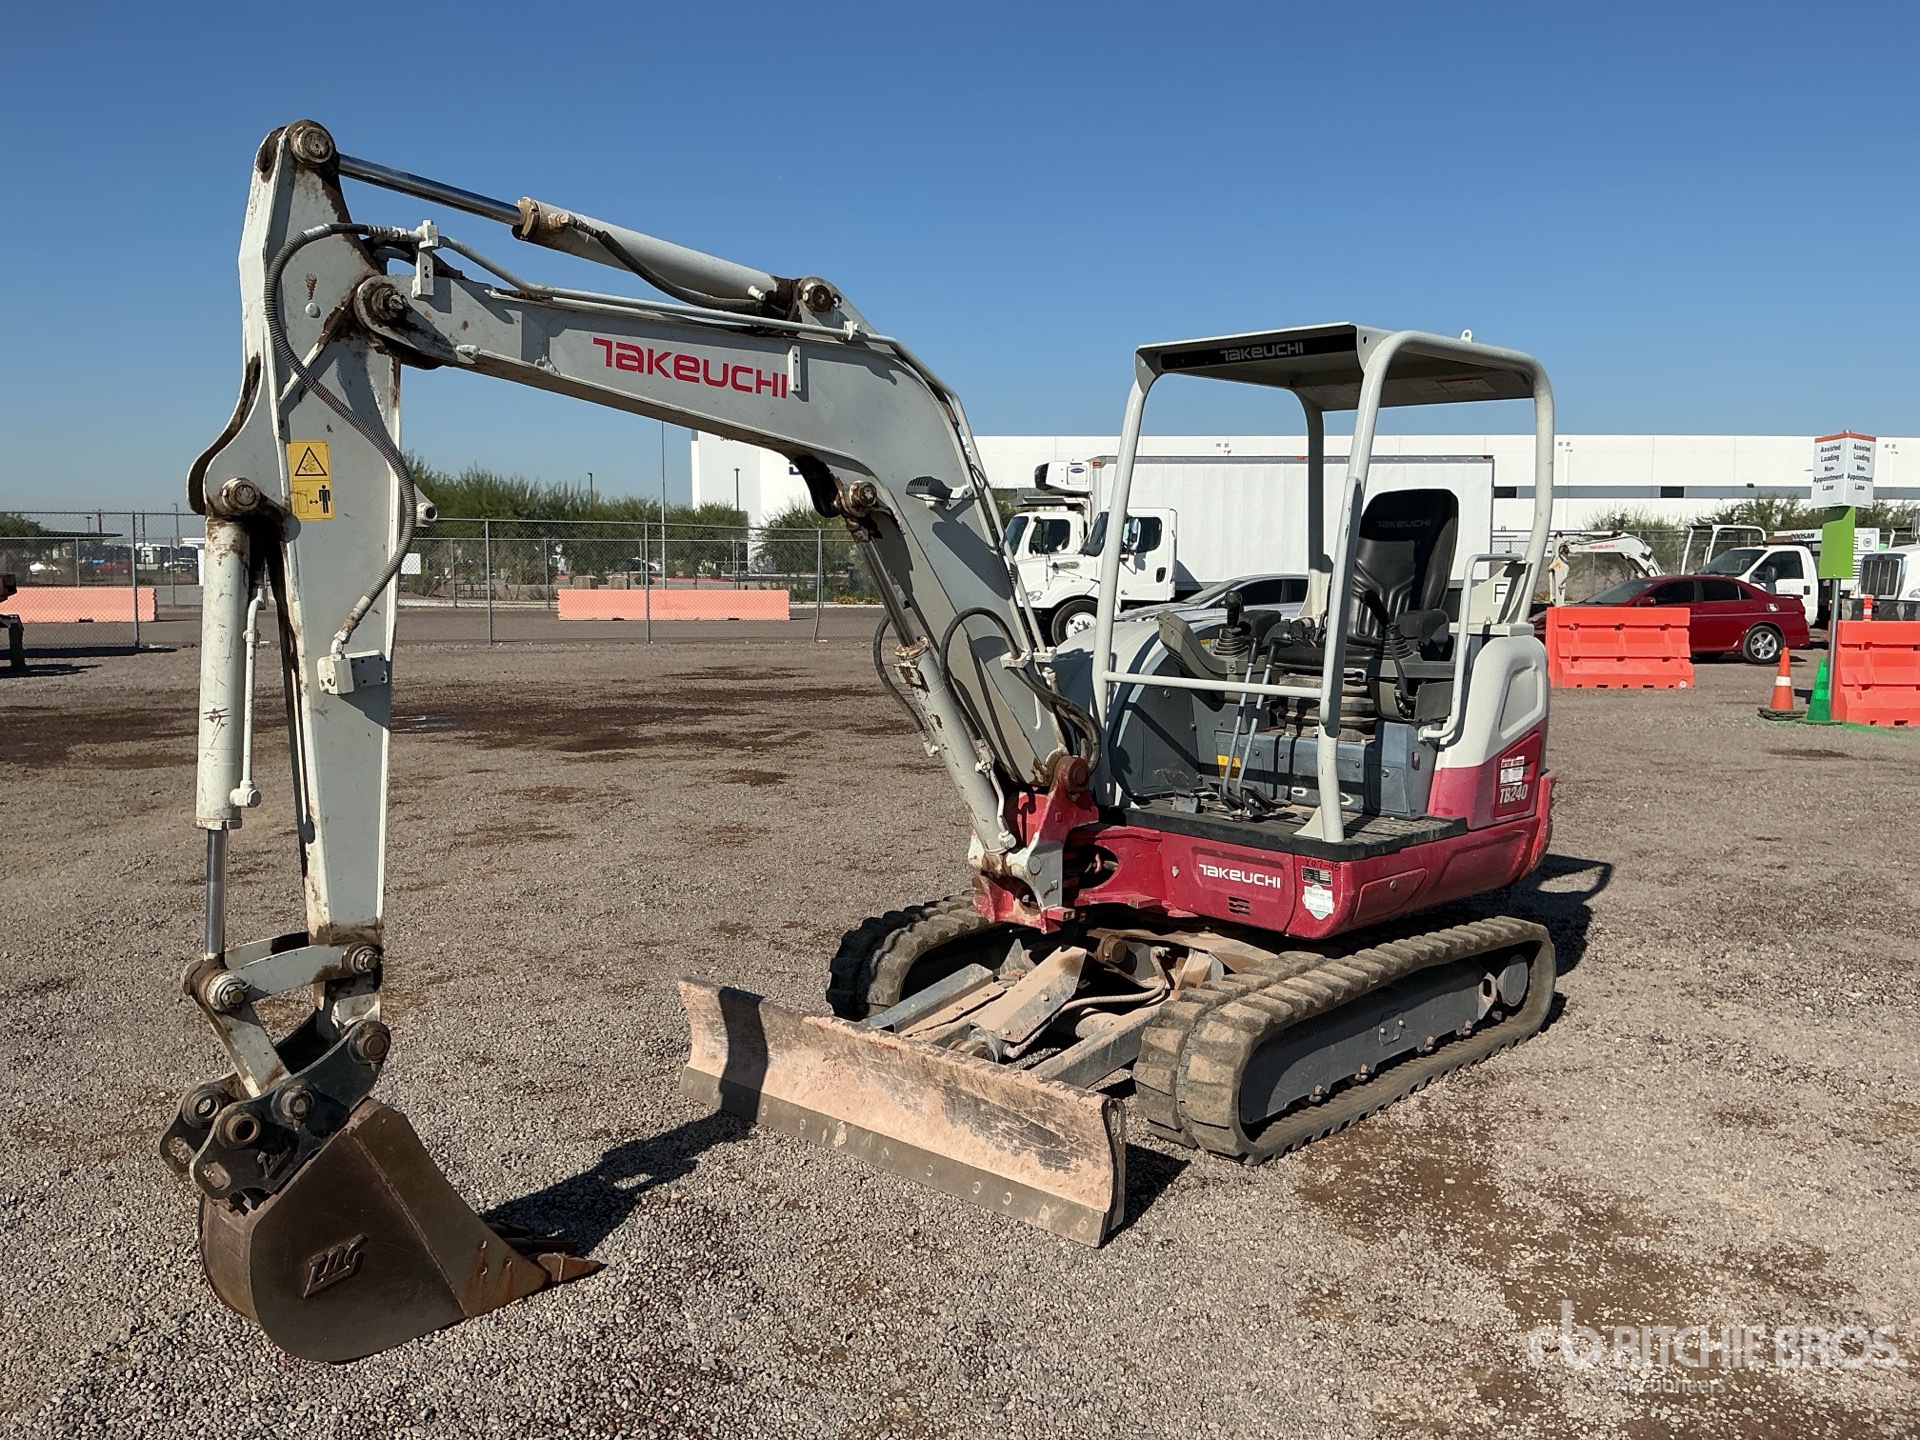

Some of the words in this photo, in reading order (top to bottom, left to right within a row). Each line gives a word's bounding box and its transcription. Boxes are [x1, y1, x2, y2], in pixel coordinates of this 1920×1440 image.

[1220, 342, 1304, 361] TAKEUCHI
[592, 336, 788, 399] TAKEUCHI
[1820, 444, 1841, 452] Assisted
[1853, 443, 1871, 452] Assisted
[1820, 454, 1840, 462] Loading
[1853, 453, 1870, 463] Loading
[1813, 473, 1844, 483] Appointment
[1847, 473, 1872, 482] Appointment
[1854, 483, 1865, 491] Lane
[1495, 583, 1508, 603] F
[1499, 783, 1529, 805] TB240
[1198, 863, 1281, 889] TAKEUCHI
